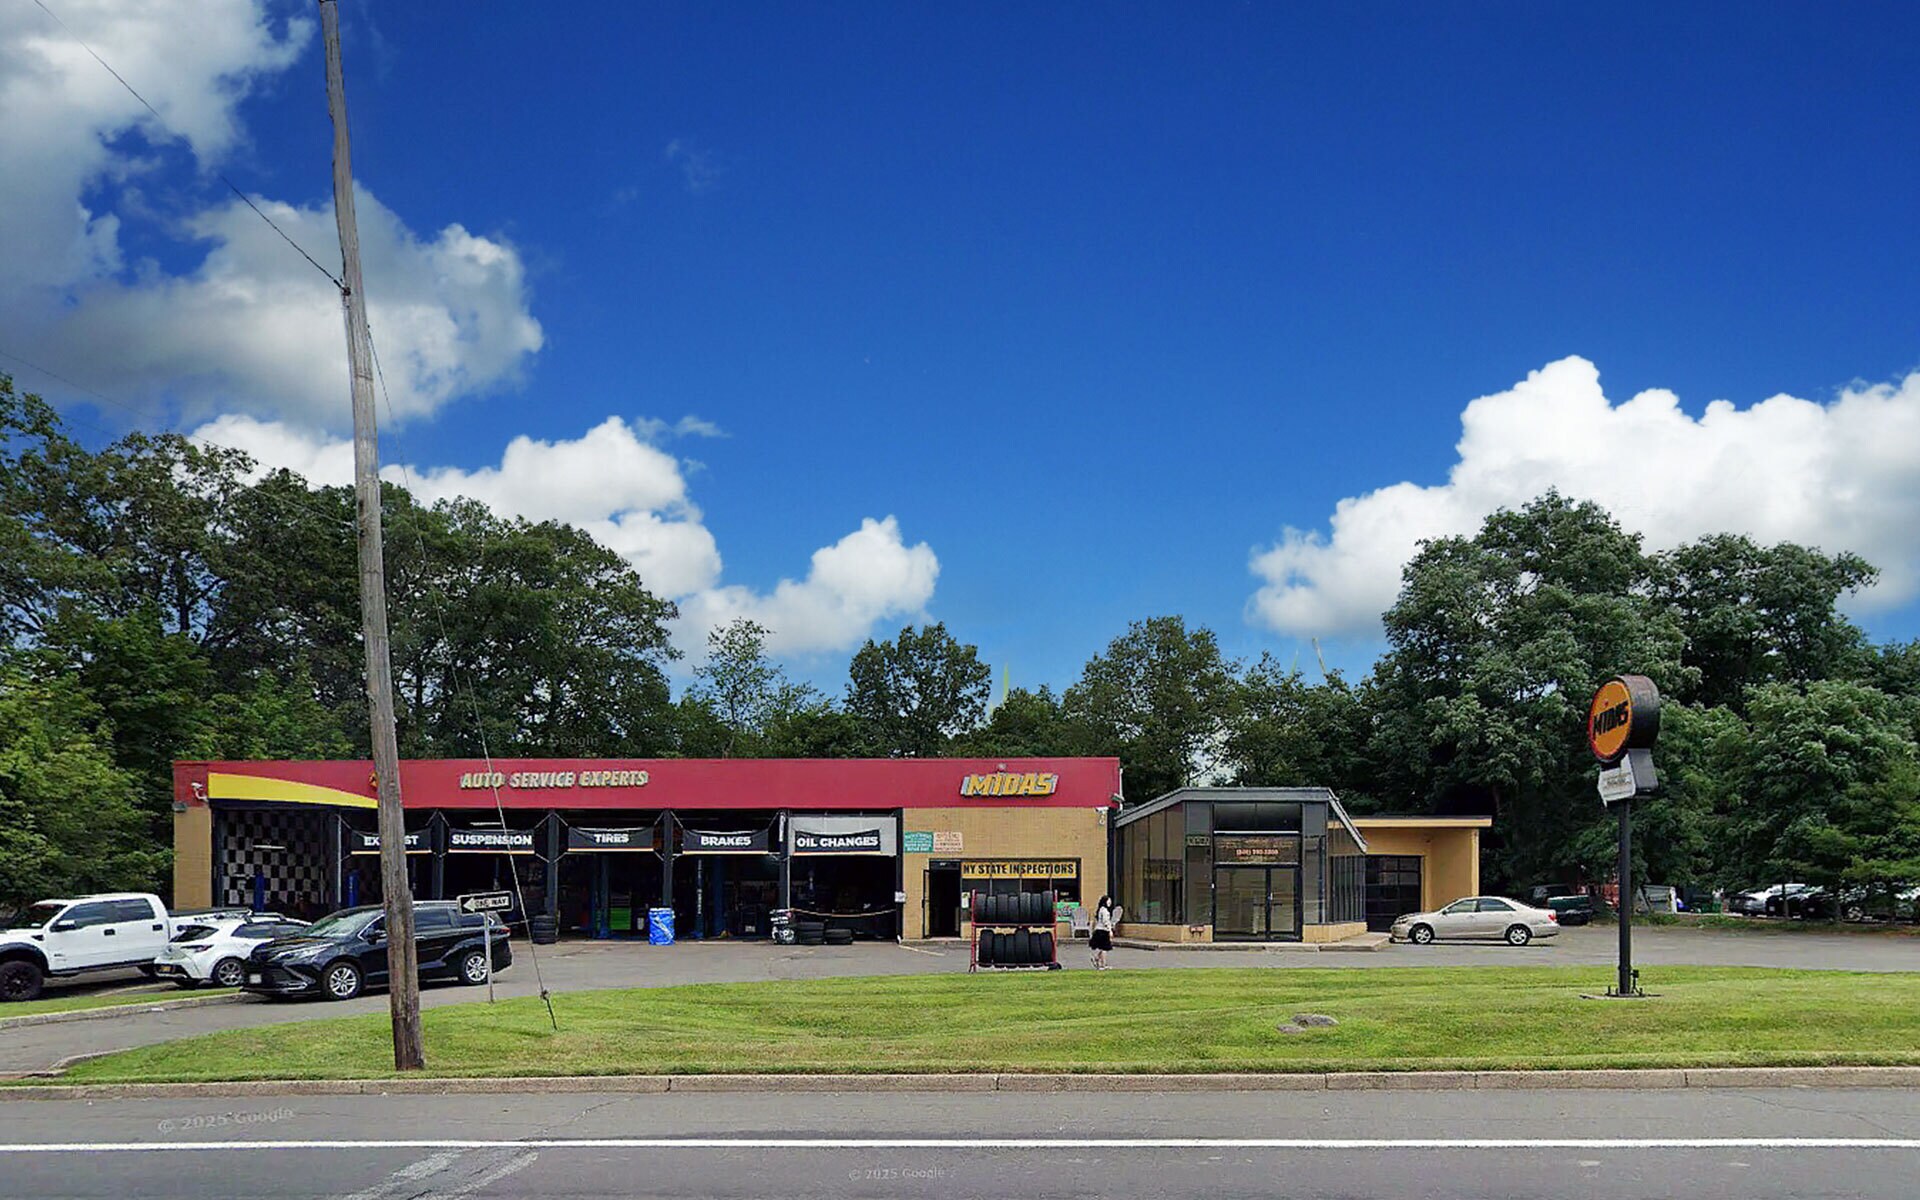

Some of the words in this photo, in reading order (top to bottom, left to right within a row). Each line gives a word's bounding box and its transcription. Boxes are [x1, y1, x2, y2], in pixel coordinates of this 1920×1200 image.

[460, 772, 504, 789] AUTO
[509, 771, 575, 788] SERVICE
[579, 770, 648, 787] EXPERTS
[363, 835, 419, 847] EXST
[451, 834, 532, 845] SUSPENSION
[594, 833, 630, 843] TIRES
[700, 835, 752, 846] BRAKES
[796, 837, 817, 848] OIL
[820, 836, 879, 847] CHANGES
[962, 863, 976, 874] NY
[978, 863, 1007, 874] STATE
[1009, 862, 1074, 874] INSPECTIONS
